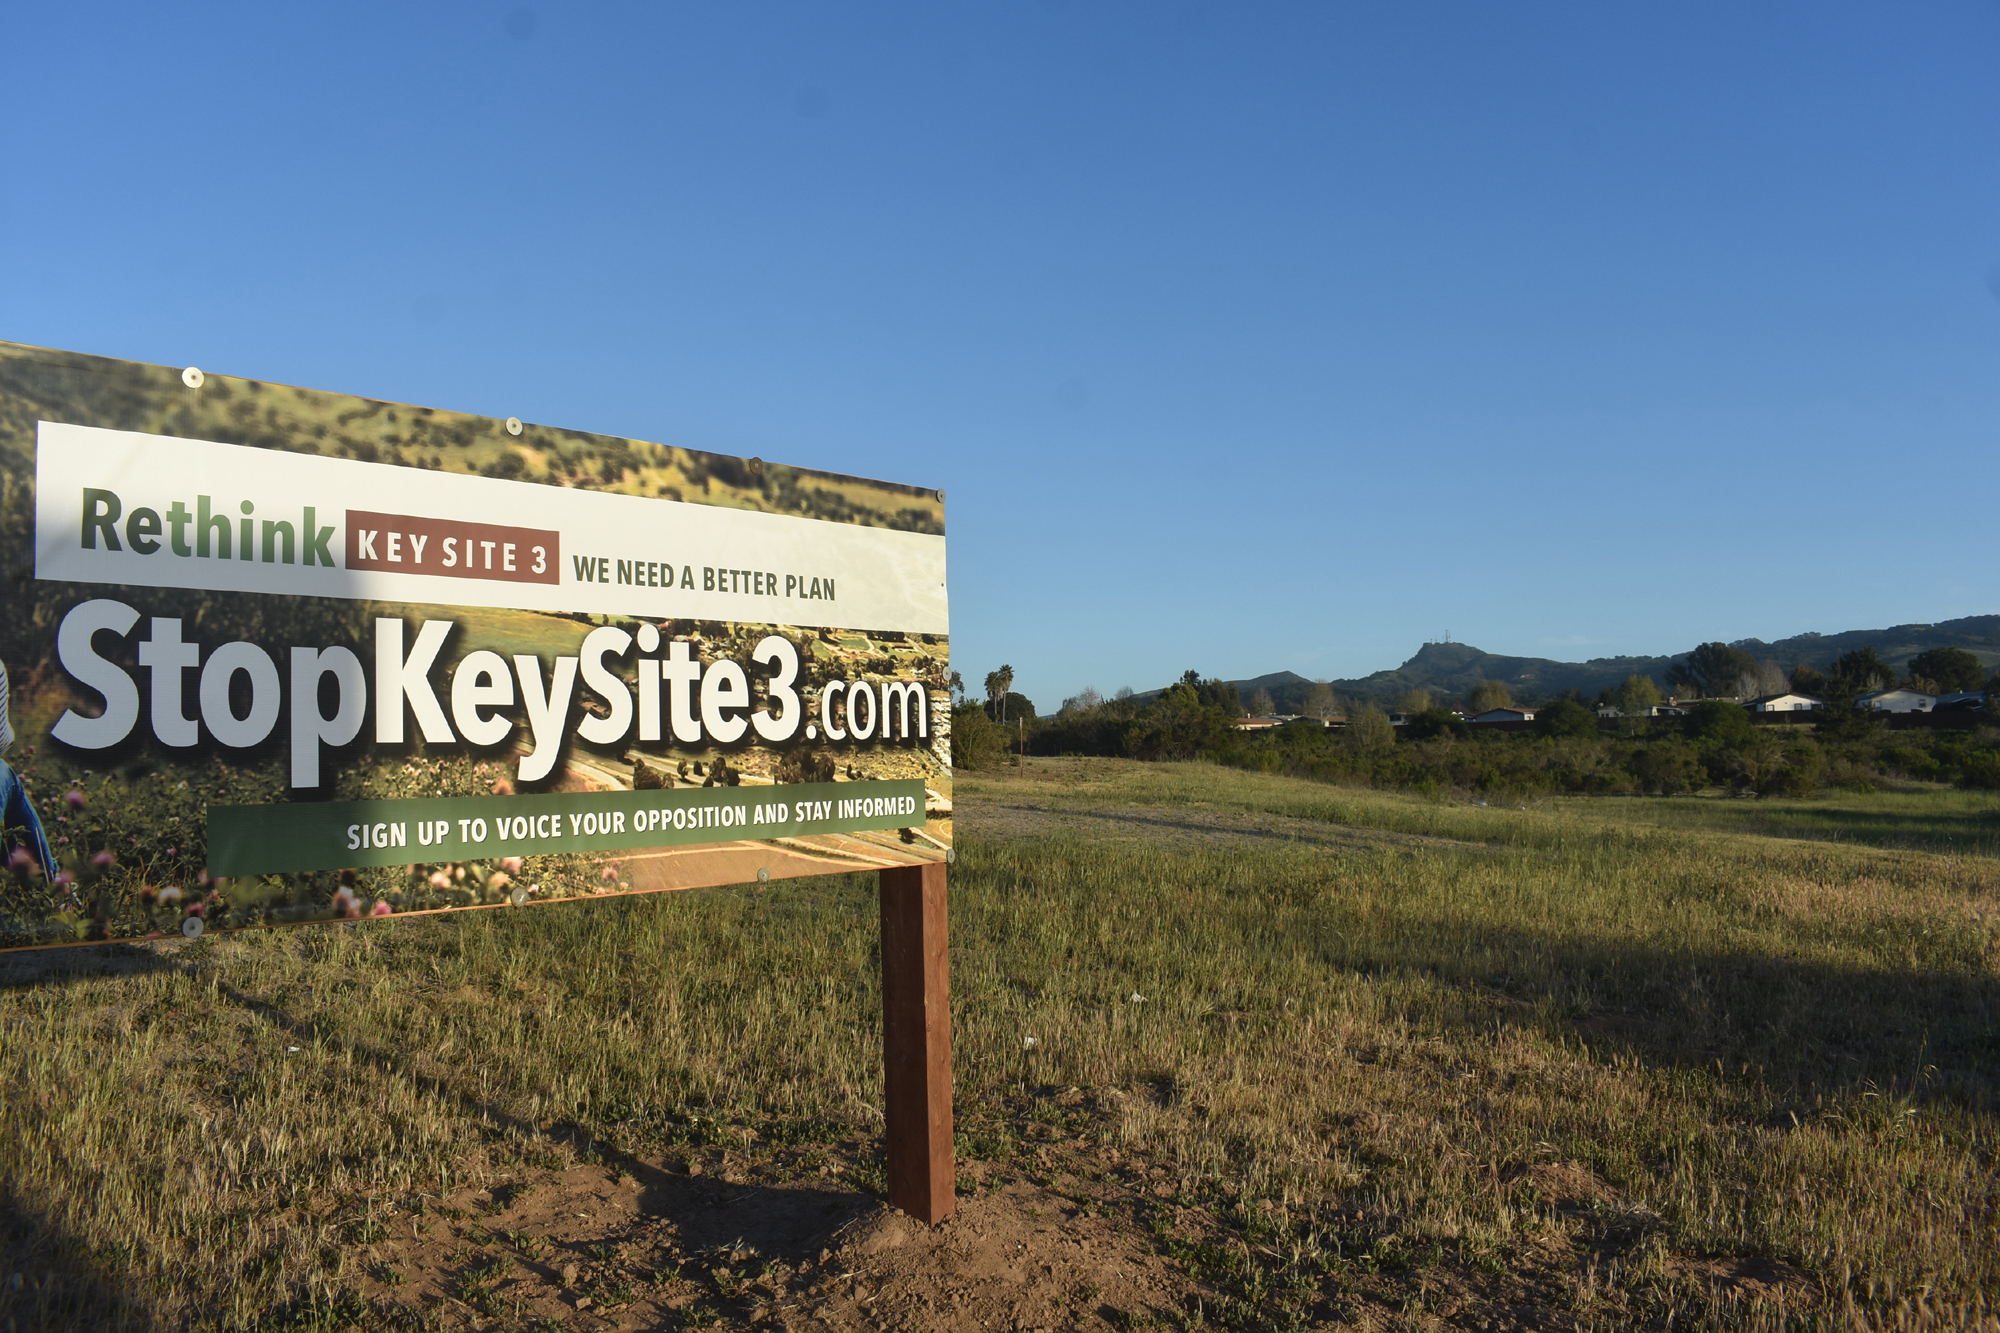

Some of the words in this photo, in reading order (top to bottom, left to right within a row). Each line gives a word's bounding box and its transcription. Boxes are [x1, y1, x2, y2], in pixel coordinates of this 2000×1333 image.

[81, 487, 336, 568] Rethink
[358, 529, 428, 563] KEY
[442, 537, 516, 571] SITE
[531, 545, 547, 574] 3
[572, 555, 609, 583] WE
[617, 559, 674, 588] NEED
[680, 565, 695, 590] A
[703, 566, 778, 596] BETTER
[785, 574, 835, 601] PLAN
[50, 599, 927, 788] StopKeySite3.com
[347, 822, 407, 850] SIGN
[418, 820, 450, 846] UP
[458, 818, 488, 843] TO
[496, 814, 562, 841] VOICE
[569, 811, 626, 836] YOUR
[633, 805, 747, 832] OPPOSITION
[753, 803, 789, 825] AND
[795, 800, 832, 822] STAY
[838, 796, 916, 819] INFORMED
